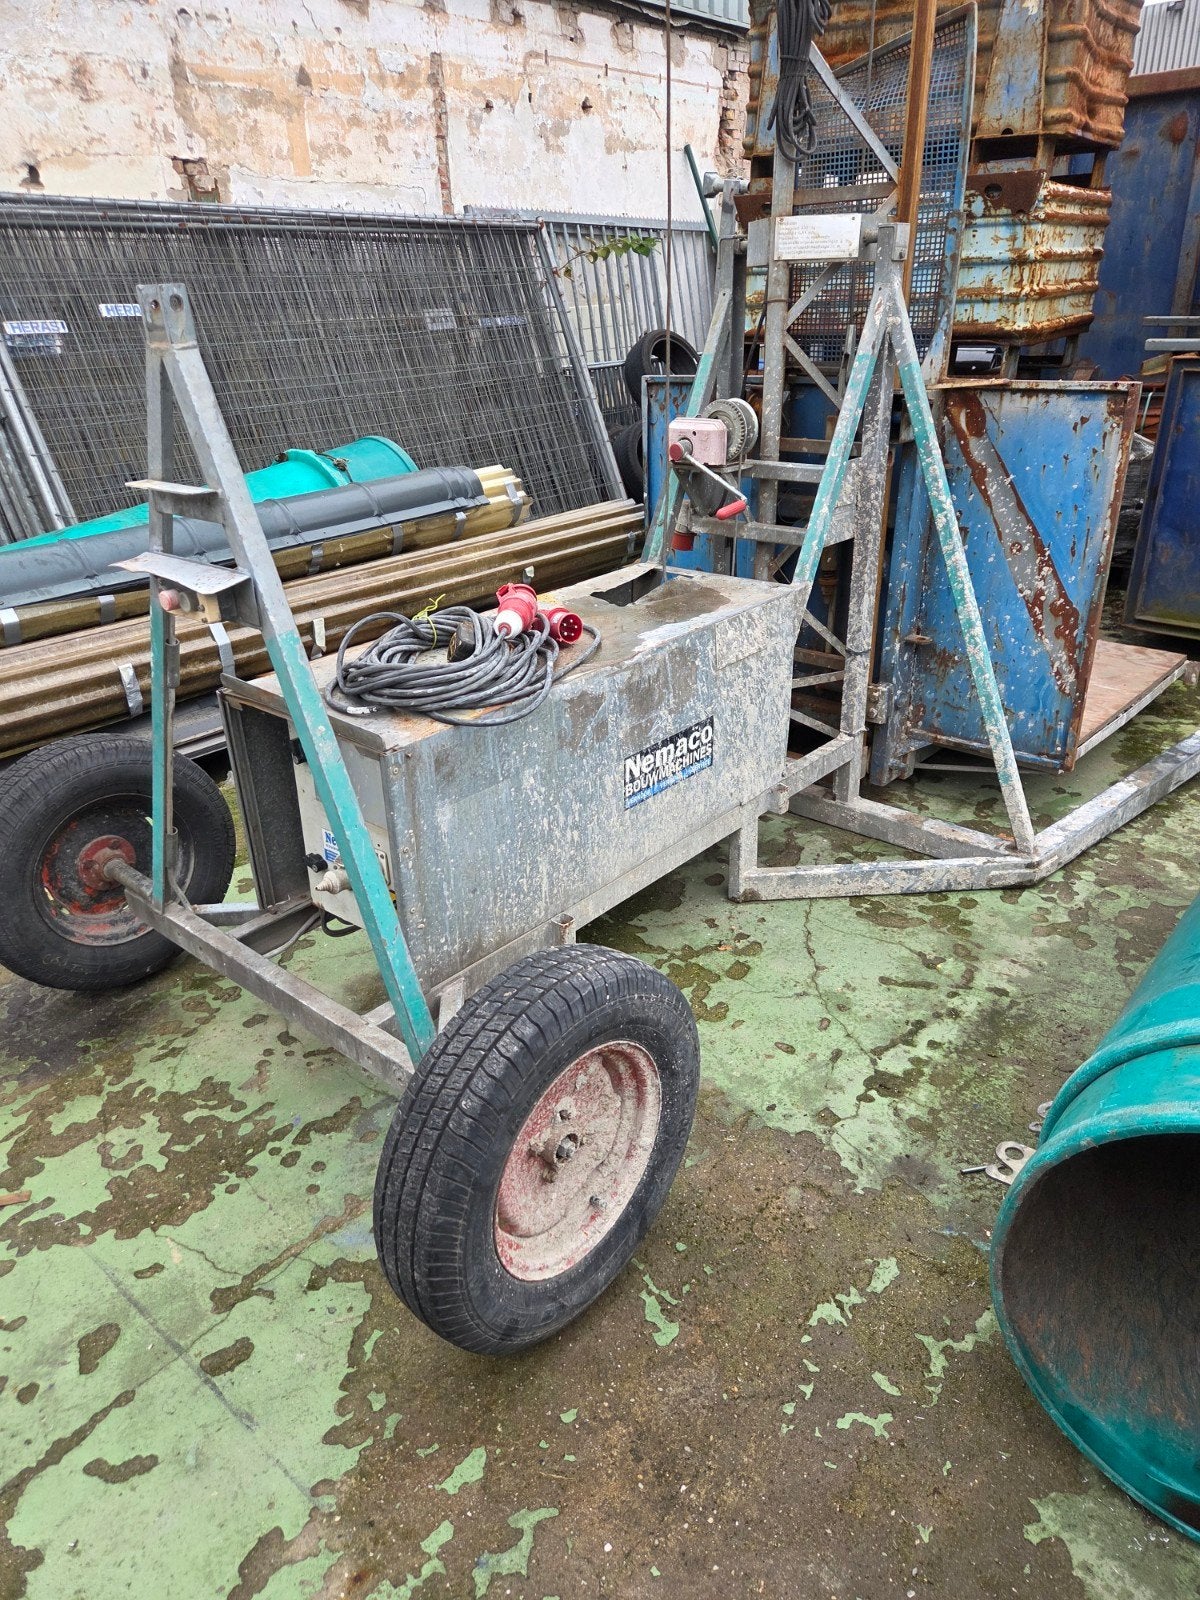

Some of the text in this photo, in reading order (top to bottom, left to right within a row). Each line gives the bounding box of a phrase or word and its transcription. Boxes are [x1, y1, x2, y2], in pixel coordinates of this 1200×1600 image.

[105, 304, 142, 316] HERA
[9, 322, 59, 333] HERAS
[624, 725, 713, 782] Nemaco
[625, 744, 713, 797] BOUWMACHINES
